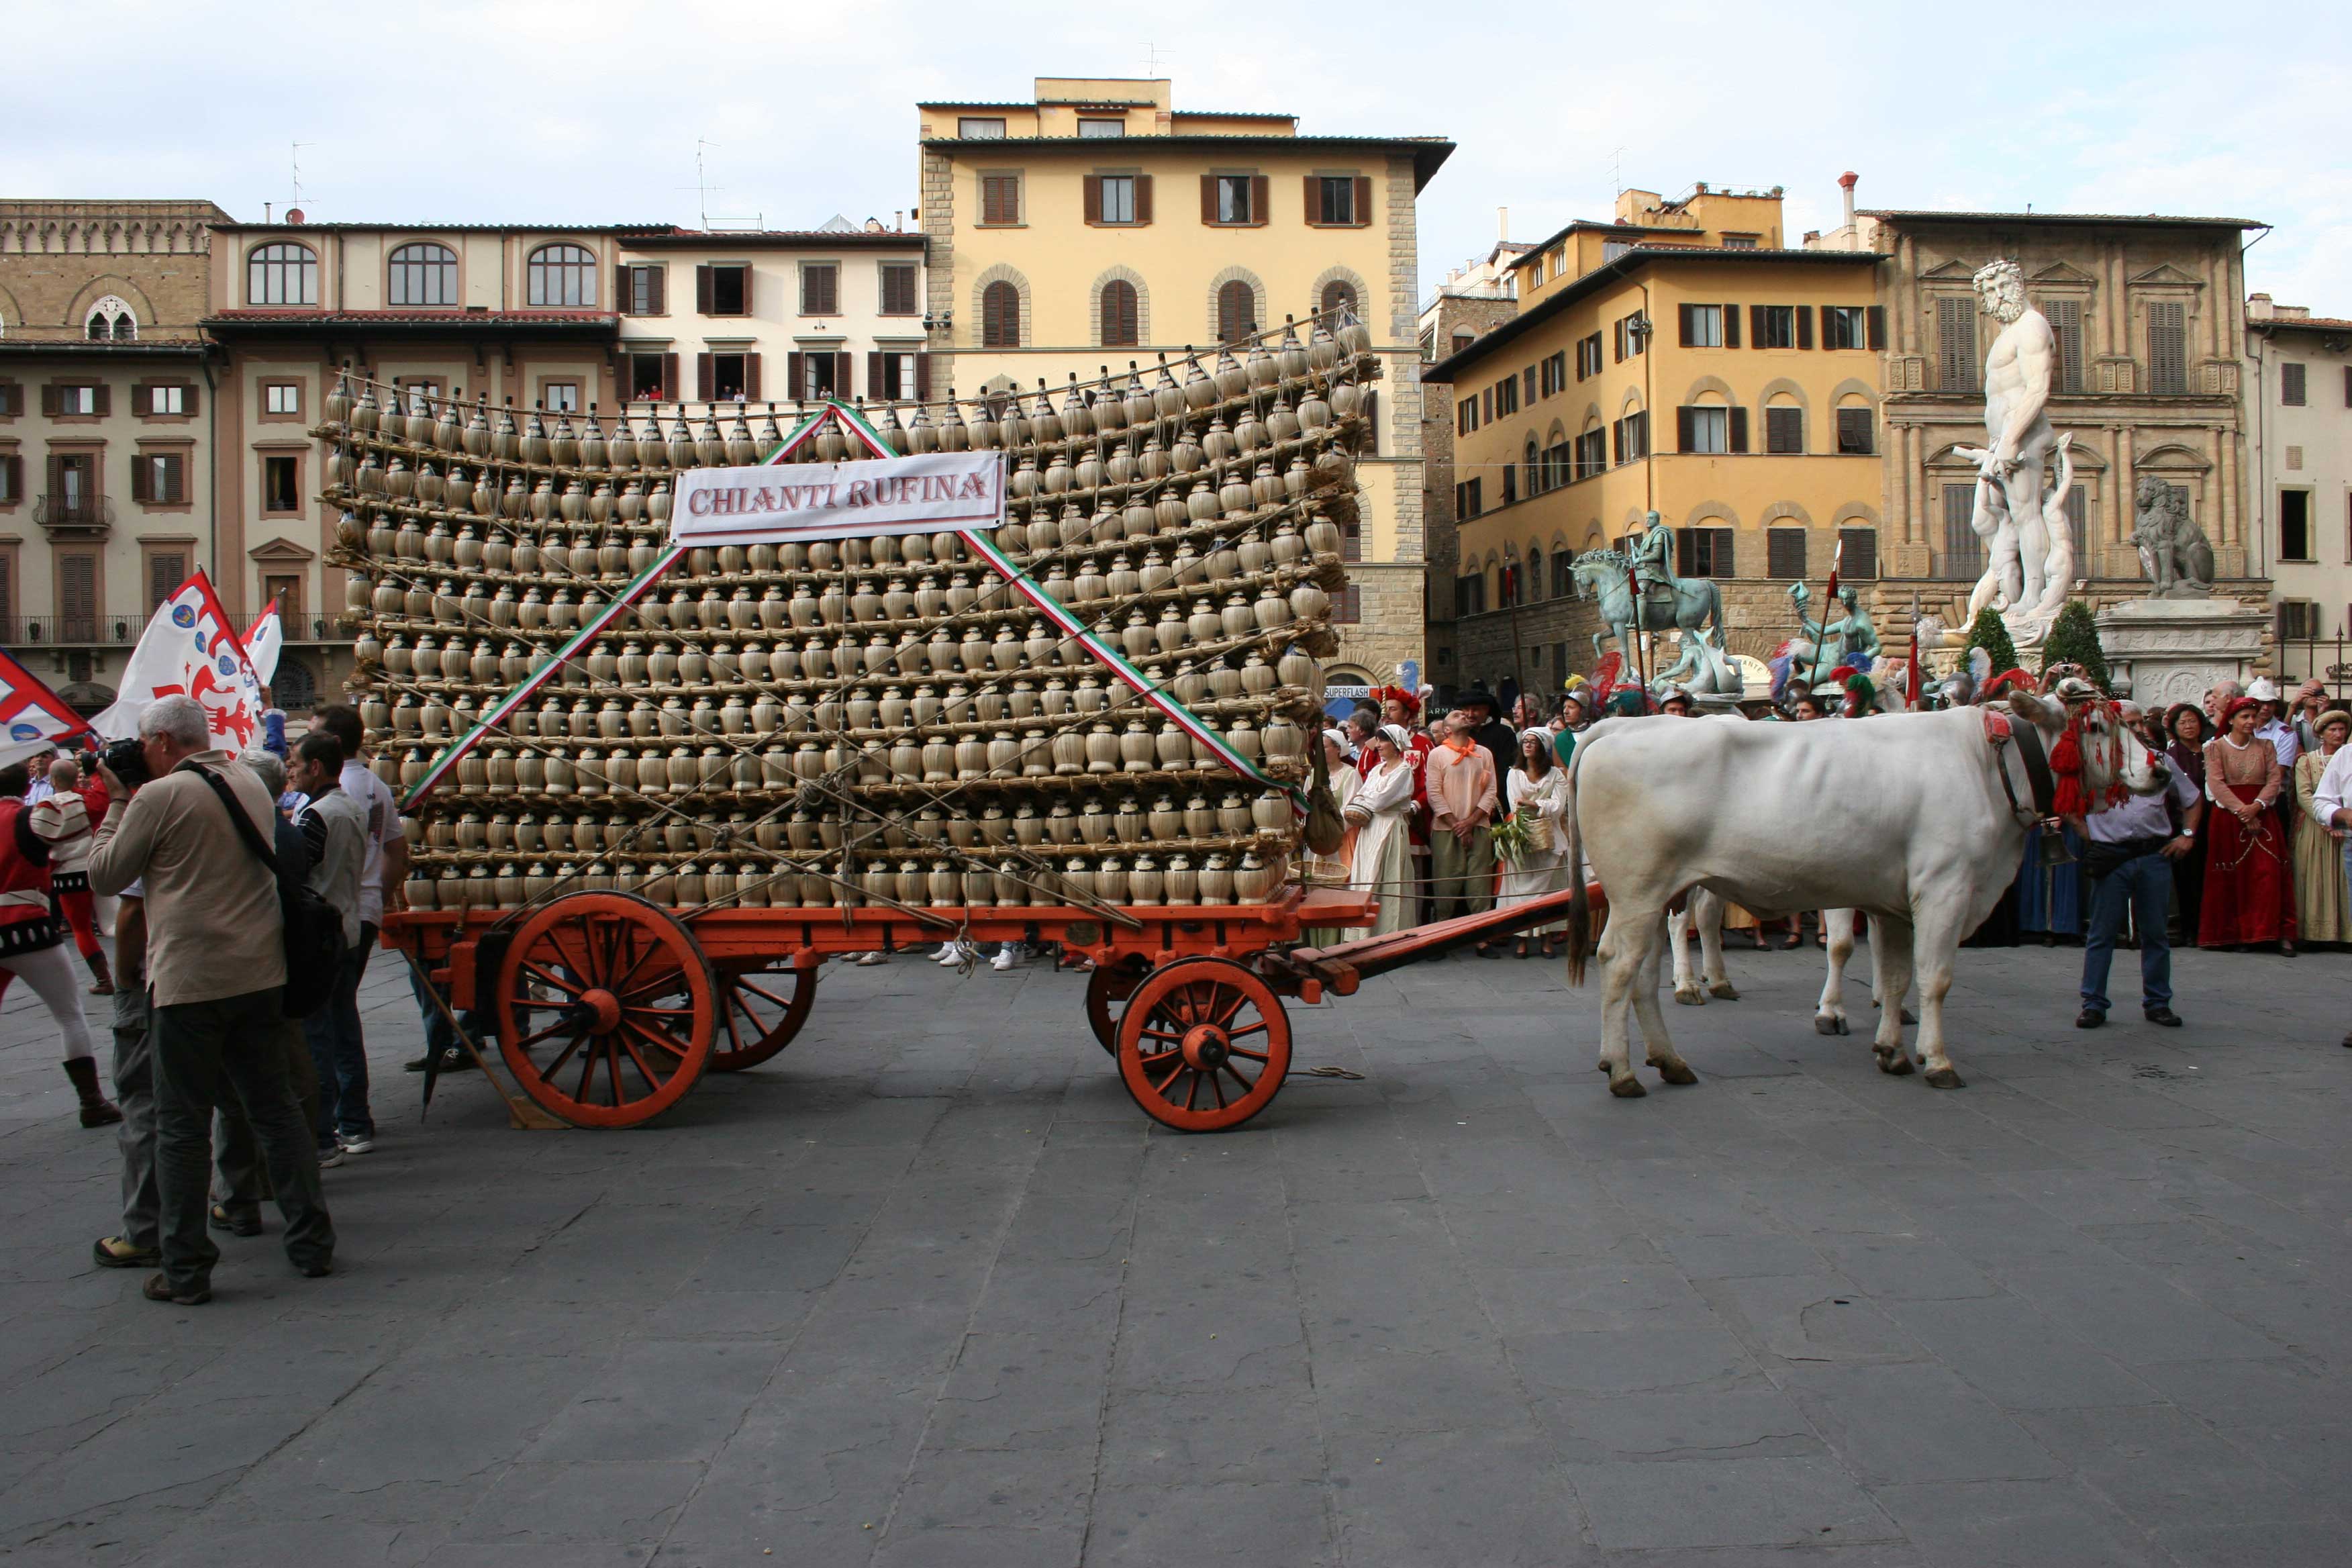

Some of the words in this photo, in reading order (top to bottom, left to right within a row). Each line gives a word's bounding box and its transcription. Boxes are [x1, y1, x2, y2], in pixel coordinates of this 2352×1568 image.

[689, 483, 838, 516] CHIANTI
[846, 472, 989, 507] RUFINA
[1325, 687, 1369, 697] SUPERFLASH
